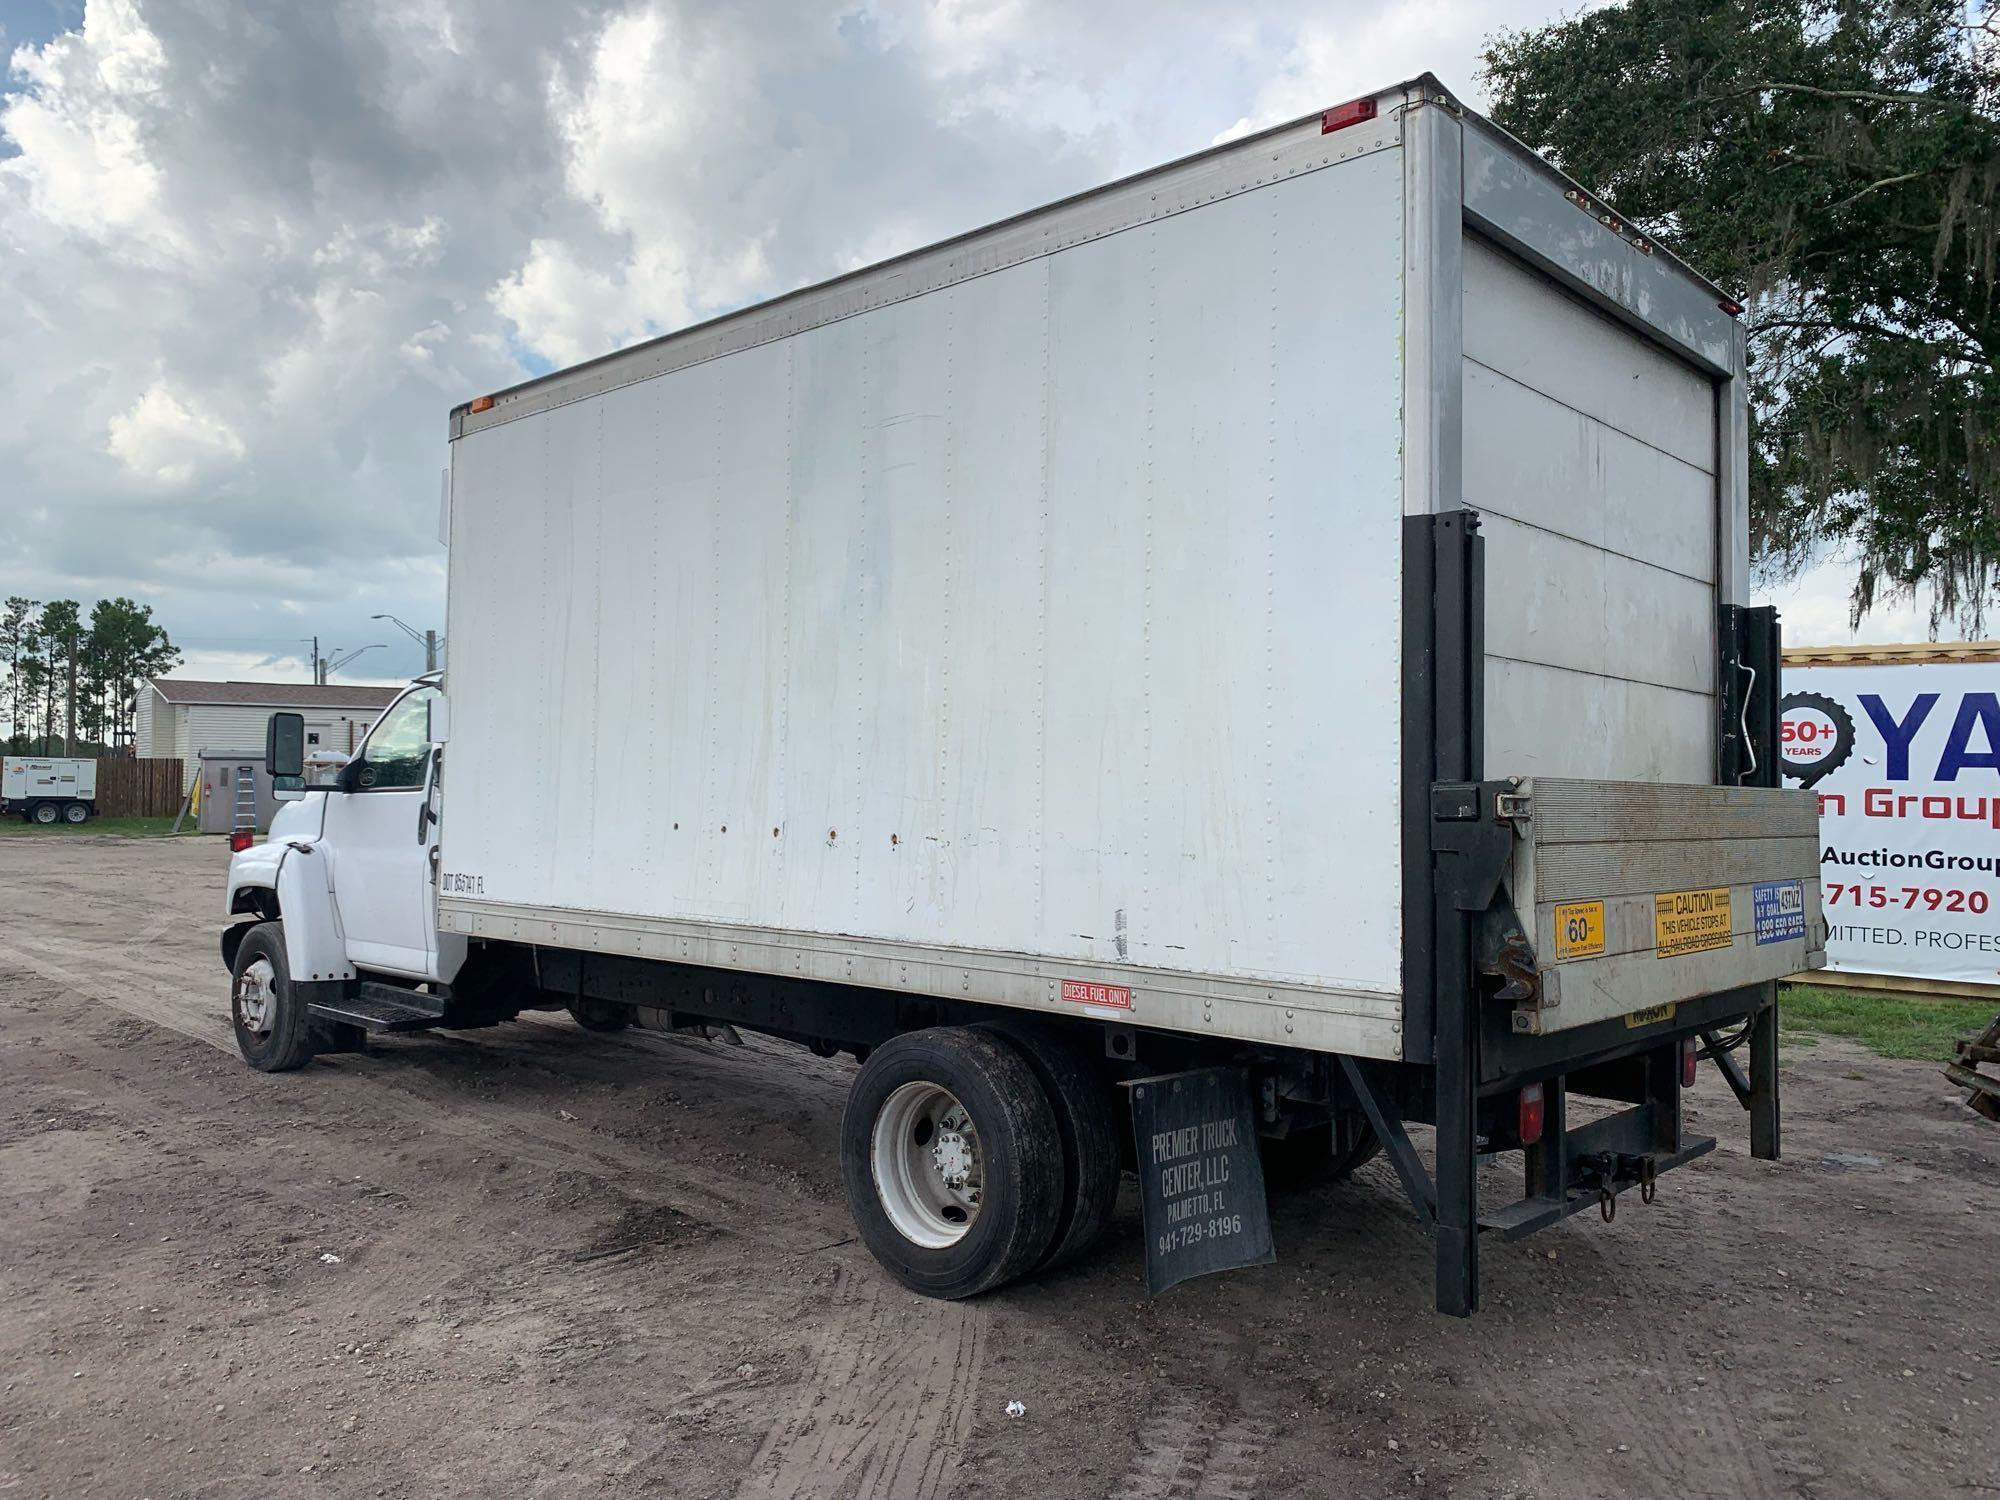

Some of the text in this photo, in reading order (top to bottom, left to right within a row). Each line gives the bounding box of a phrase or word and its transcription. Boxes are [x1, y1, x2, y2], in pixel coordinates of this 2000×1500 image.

[1781, 721, 1835, 742] 50+
[1785, 747, 1822, 756] YEARS
[1676, 892, 1713, 915] CAUTION
[1755, 887, 1773, 902] SAFETY
[1569, 917, 1587, 943] 60
[1662, 913, 1727, 936] THIS VEHICLE STOPS AT
[1064, 984, 1127, 1005] DIESEL FUEL ONLY
[1152, 1118, 1238, 1164] PREMIER TRUCK
[1162, 1154, 1229, 1198] CENTER, LLC
[1167, 1190, 1225, 1225] PALMETTO, FL
[1159, 1214, 1242, 1256] 941-729-8196
